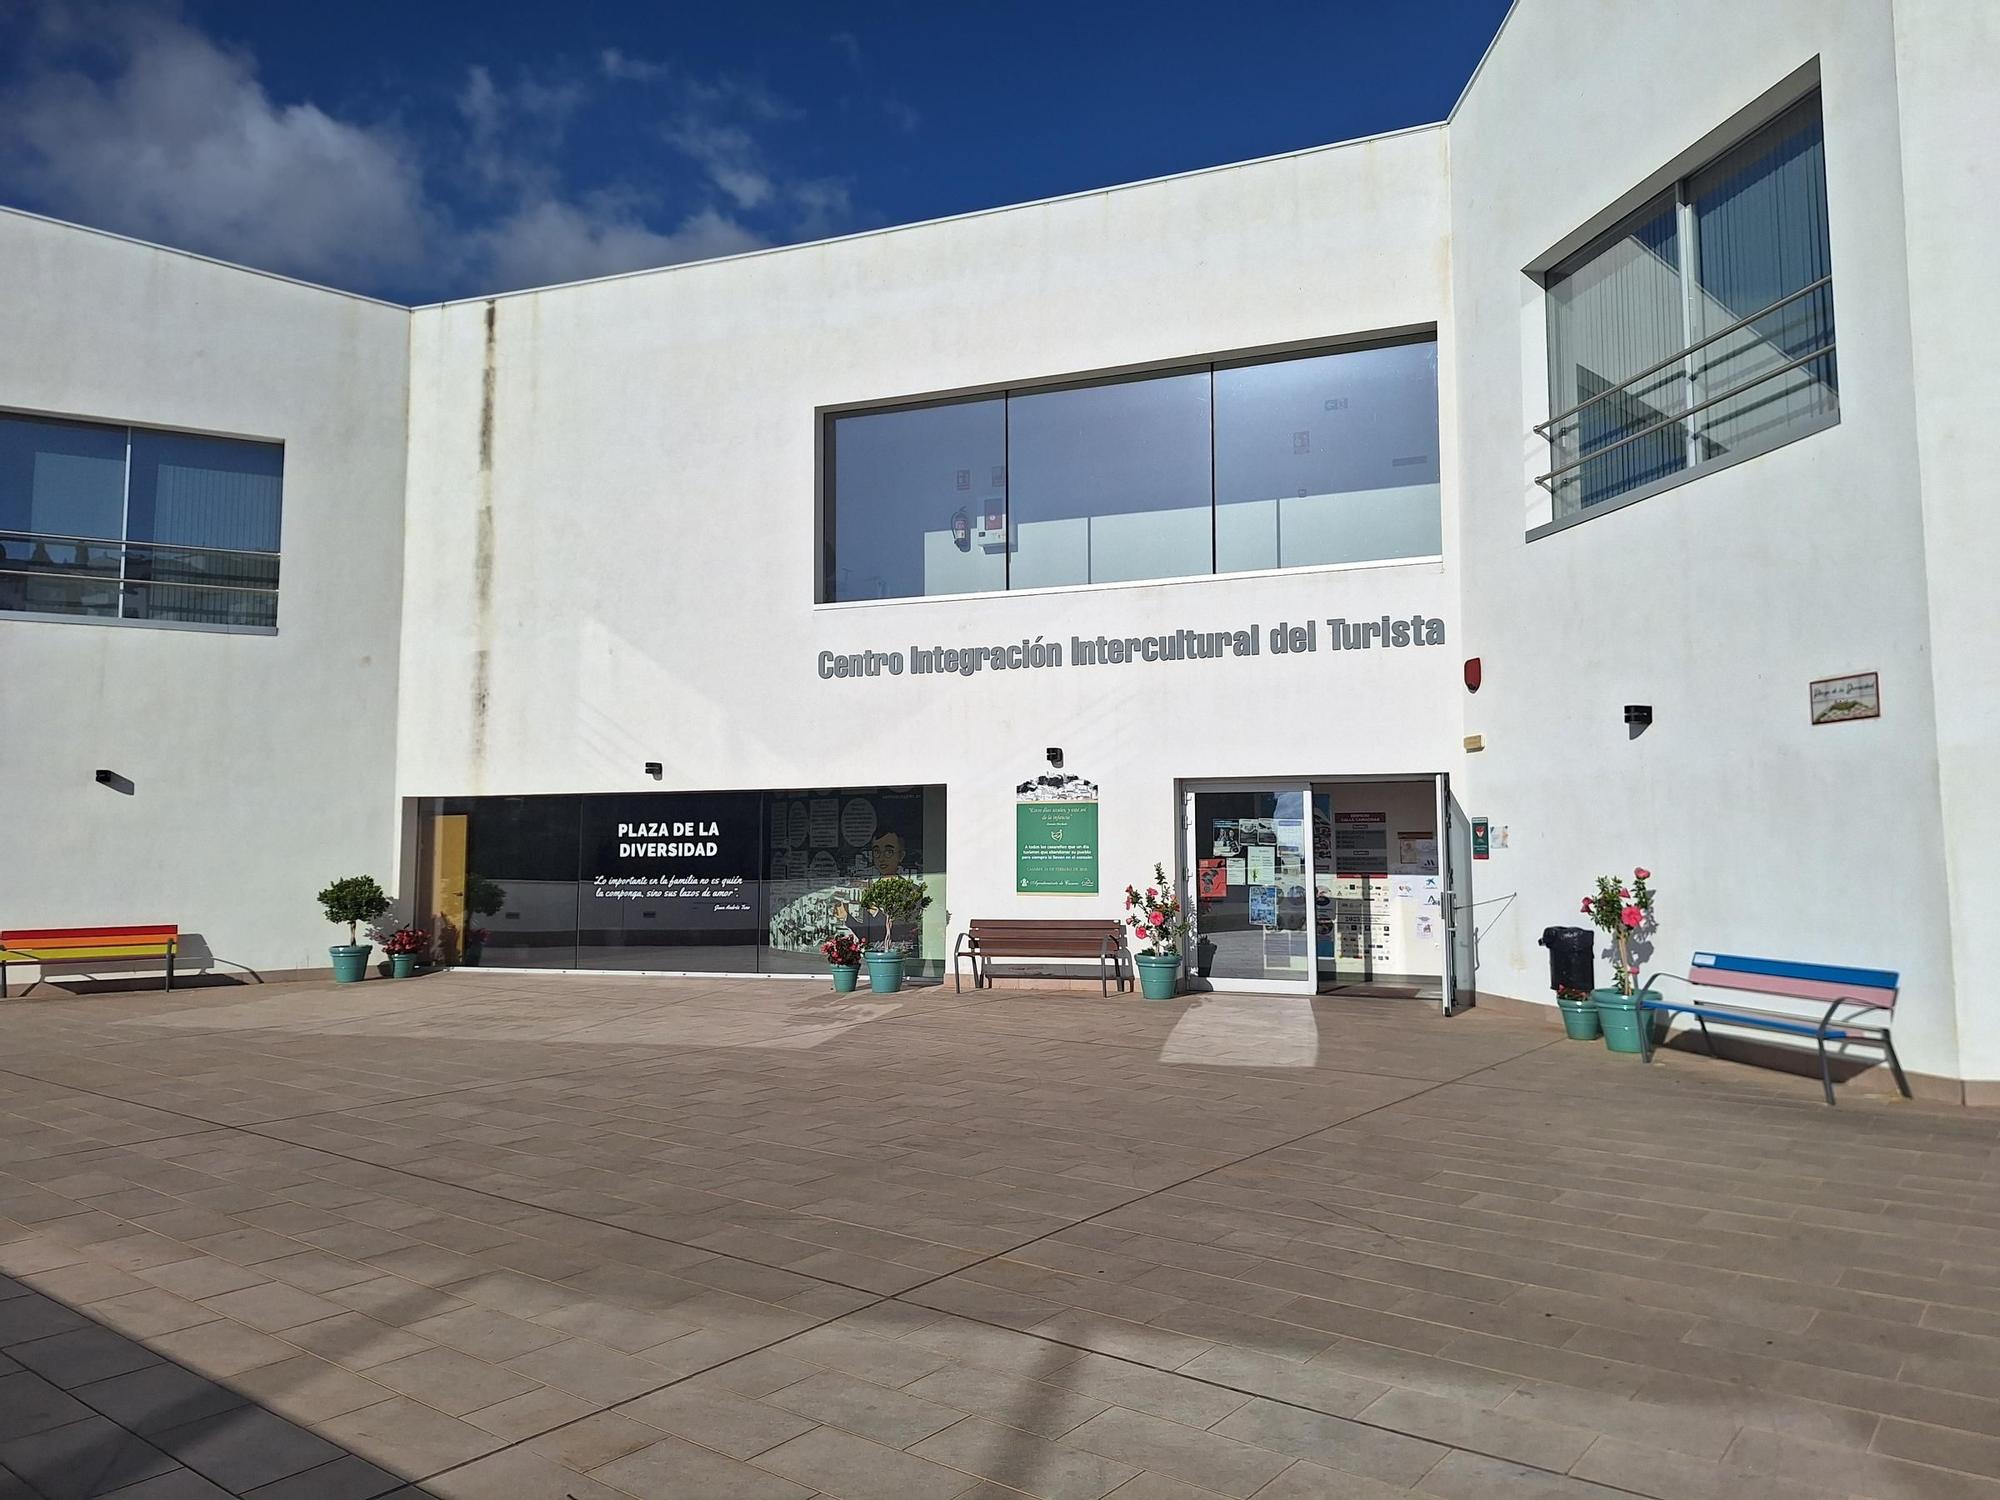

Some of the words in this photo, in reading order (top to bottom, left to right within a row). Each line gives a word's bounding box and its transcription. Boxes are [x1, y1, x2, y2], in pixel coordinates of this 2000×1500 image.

[818, 650, 904, 679] Centro
[910, 635, 1063, 677] Integración
[1070, 624, 1260, 666] Intercultural
[1269, 619, 1317, 655] del
[1326, 615, 1446, 651] Turista
[618, 822, 669, 837] PLAZA
[673, 822, 694, 836] DE
[698, 821, 720, 836] LA
[619, 842, 718, 857] DIVERSIDAD
[608, 876, 648, 888] importante
[660, 874, 669, 885] la
[668, 874, 699, 888] familia
[721, 875, 743, 888] quién
[595, 887, 604, 897] la
[605, 889, 644, 900] componga,
[646, 889, 663, 897] sino
[679, 887, 700, 897] lazos
[701, 887, 711, 897] de
